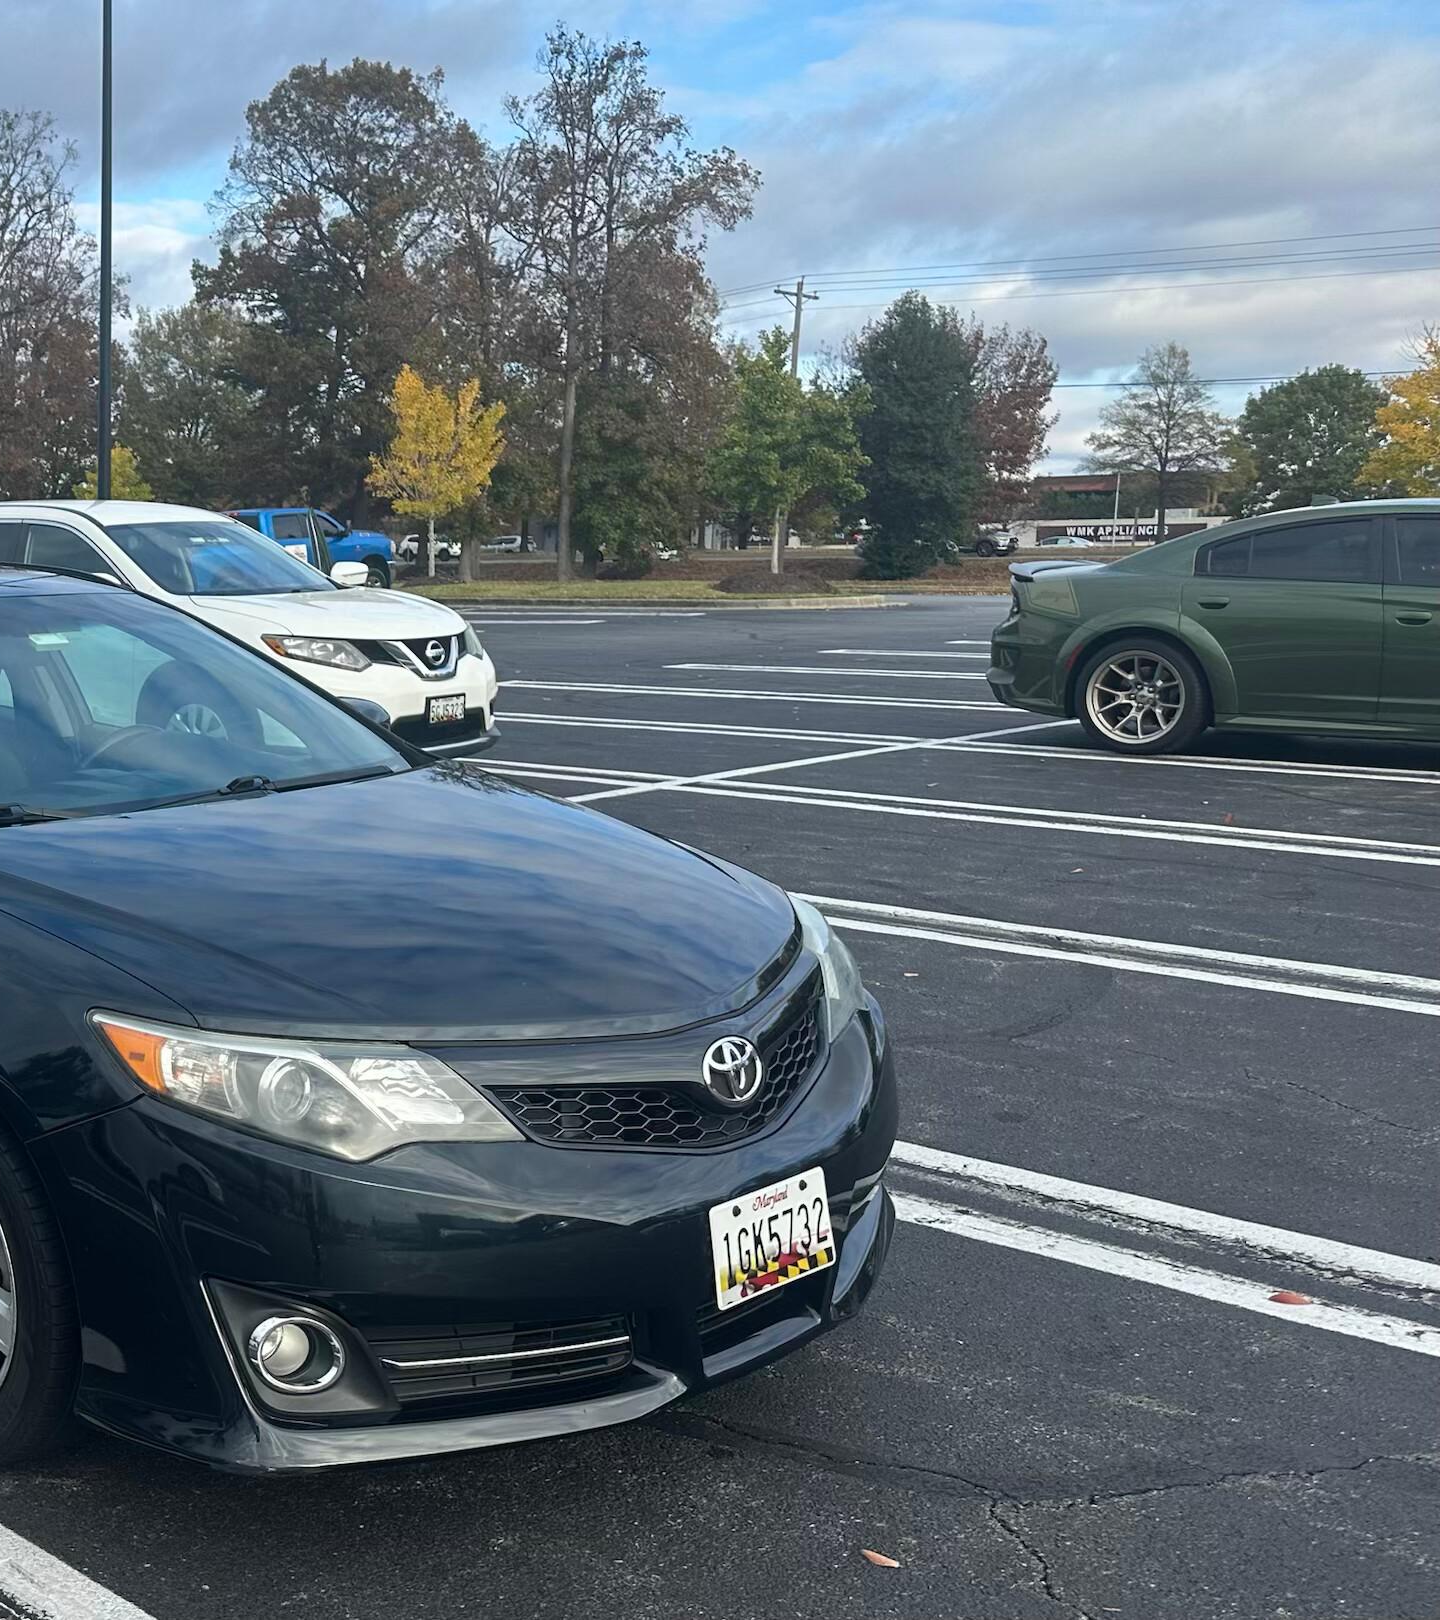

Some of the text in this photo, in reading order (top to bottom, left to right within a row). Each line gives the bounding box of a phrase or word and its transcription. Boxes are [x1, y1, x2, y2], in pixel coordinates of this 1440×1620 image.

[1066, 526, 1094, 536] WMK
[752, 1184, 788, 1211] Maryland
[723, 1197, 828, 1280] 1GK5732
